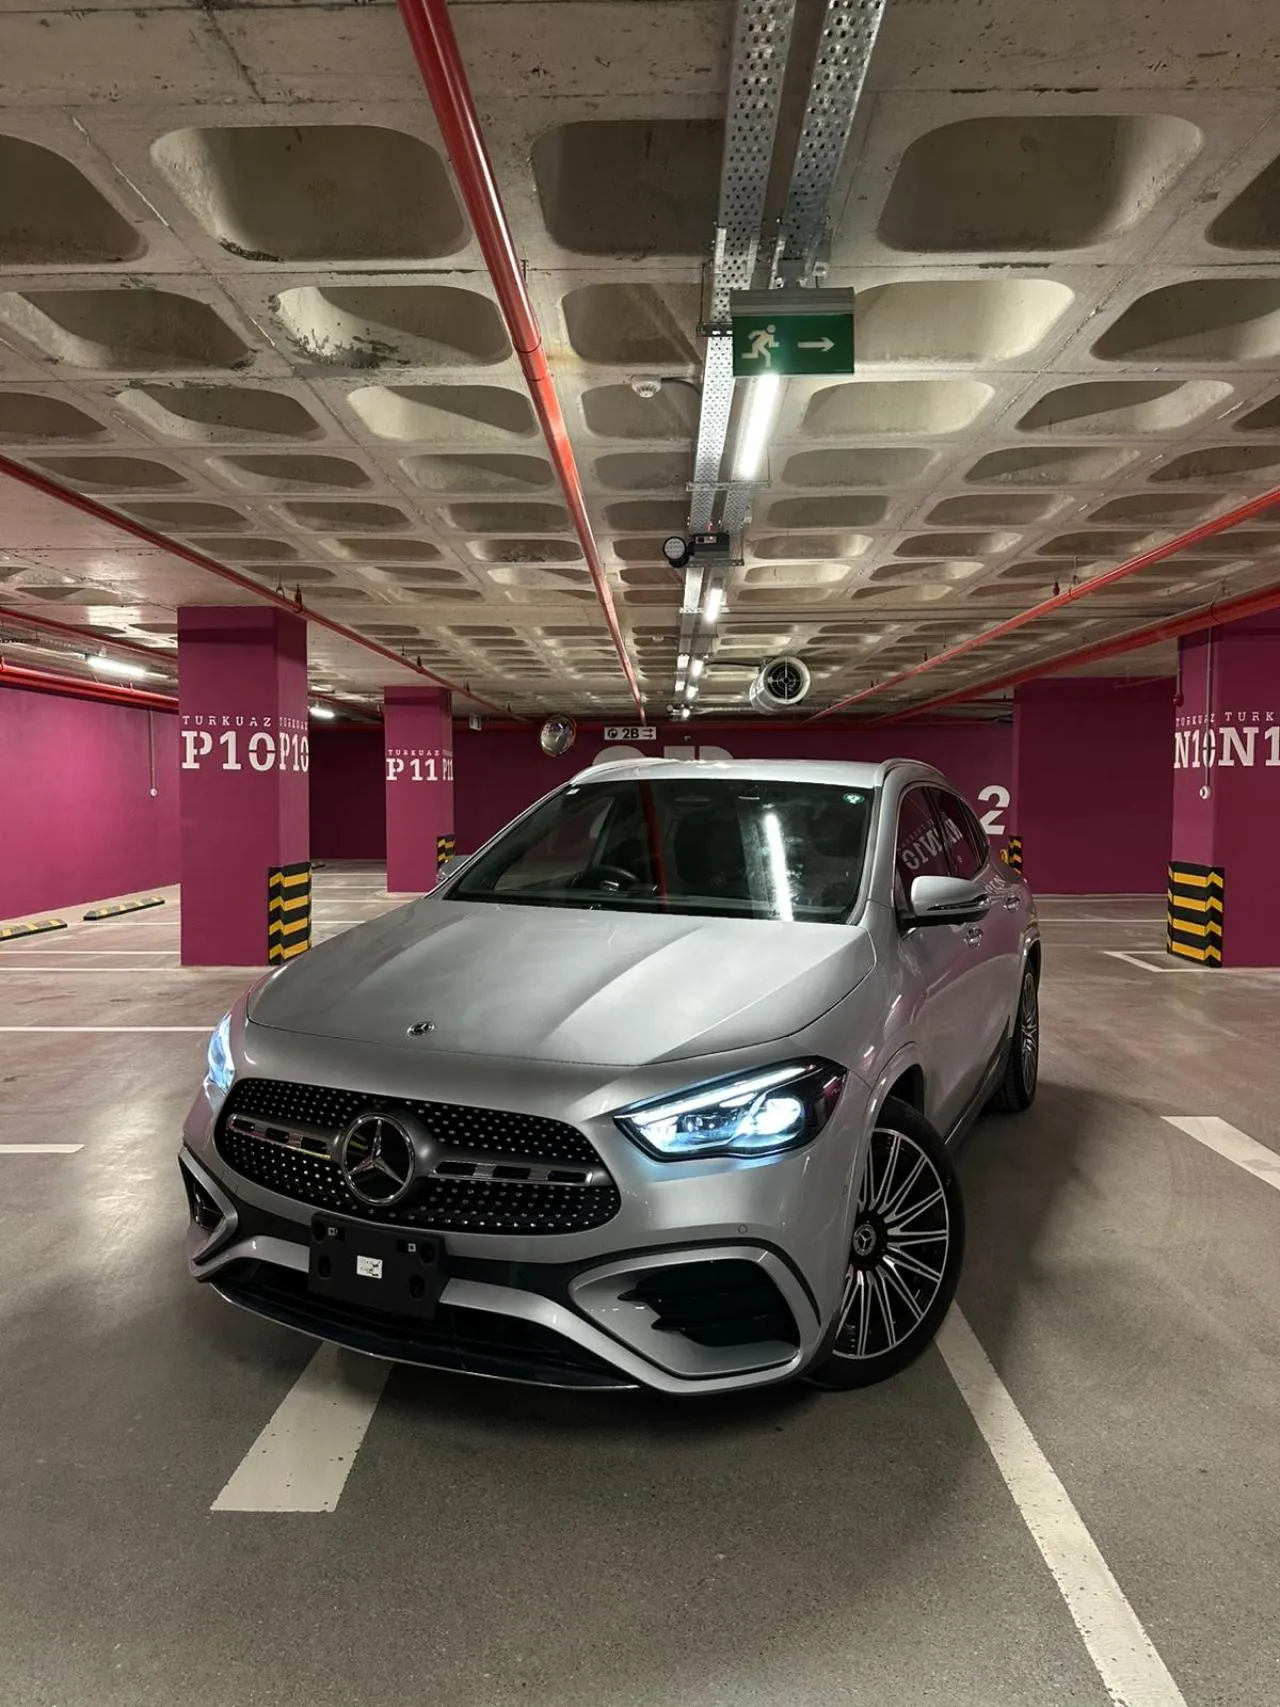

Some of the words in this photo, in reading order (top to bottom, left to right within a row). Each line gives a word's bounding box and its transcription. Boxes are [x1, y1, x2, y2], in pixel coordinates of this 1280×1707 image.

[182, 715, 272, 727] TURKUAZ
[1225, 711, 1274, 722] TURK
[621, 728, 639, 739] 2B
[181, 730, 276, 771] P10
[279, 732, 309, 772] P10
[387, 749, 440, 757] TURKUAZ
[1174, 728, 1216, 769] N10
[386, 758, 438, 781] P11
[977, 784, 1011, 836] 2
